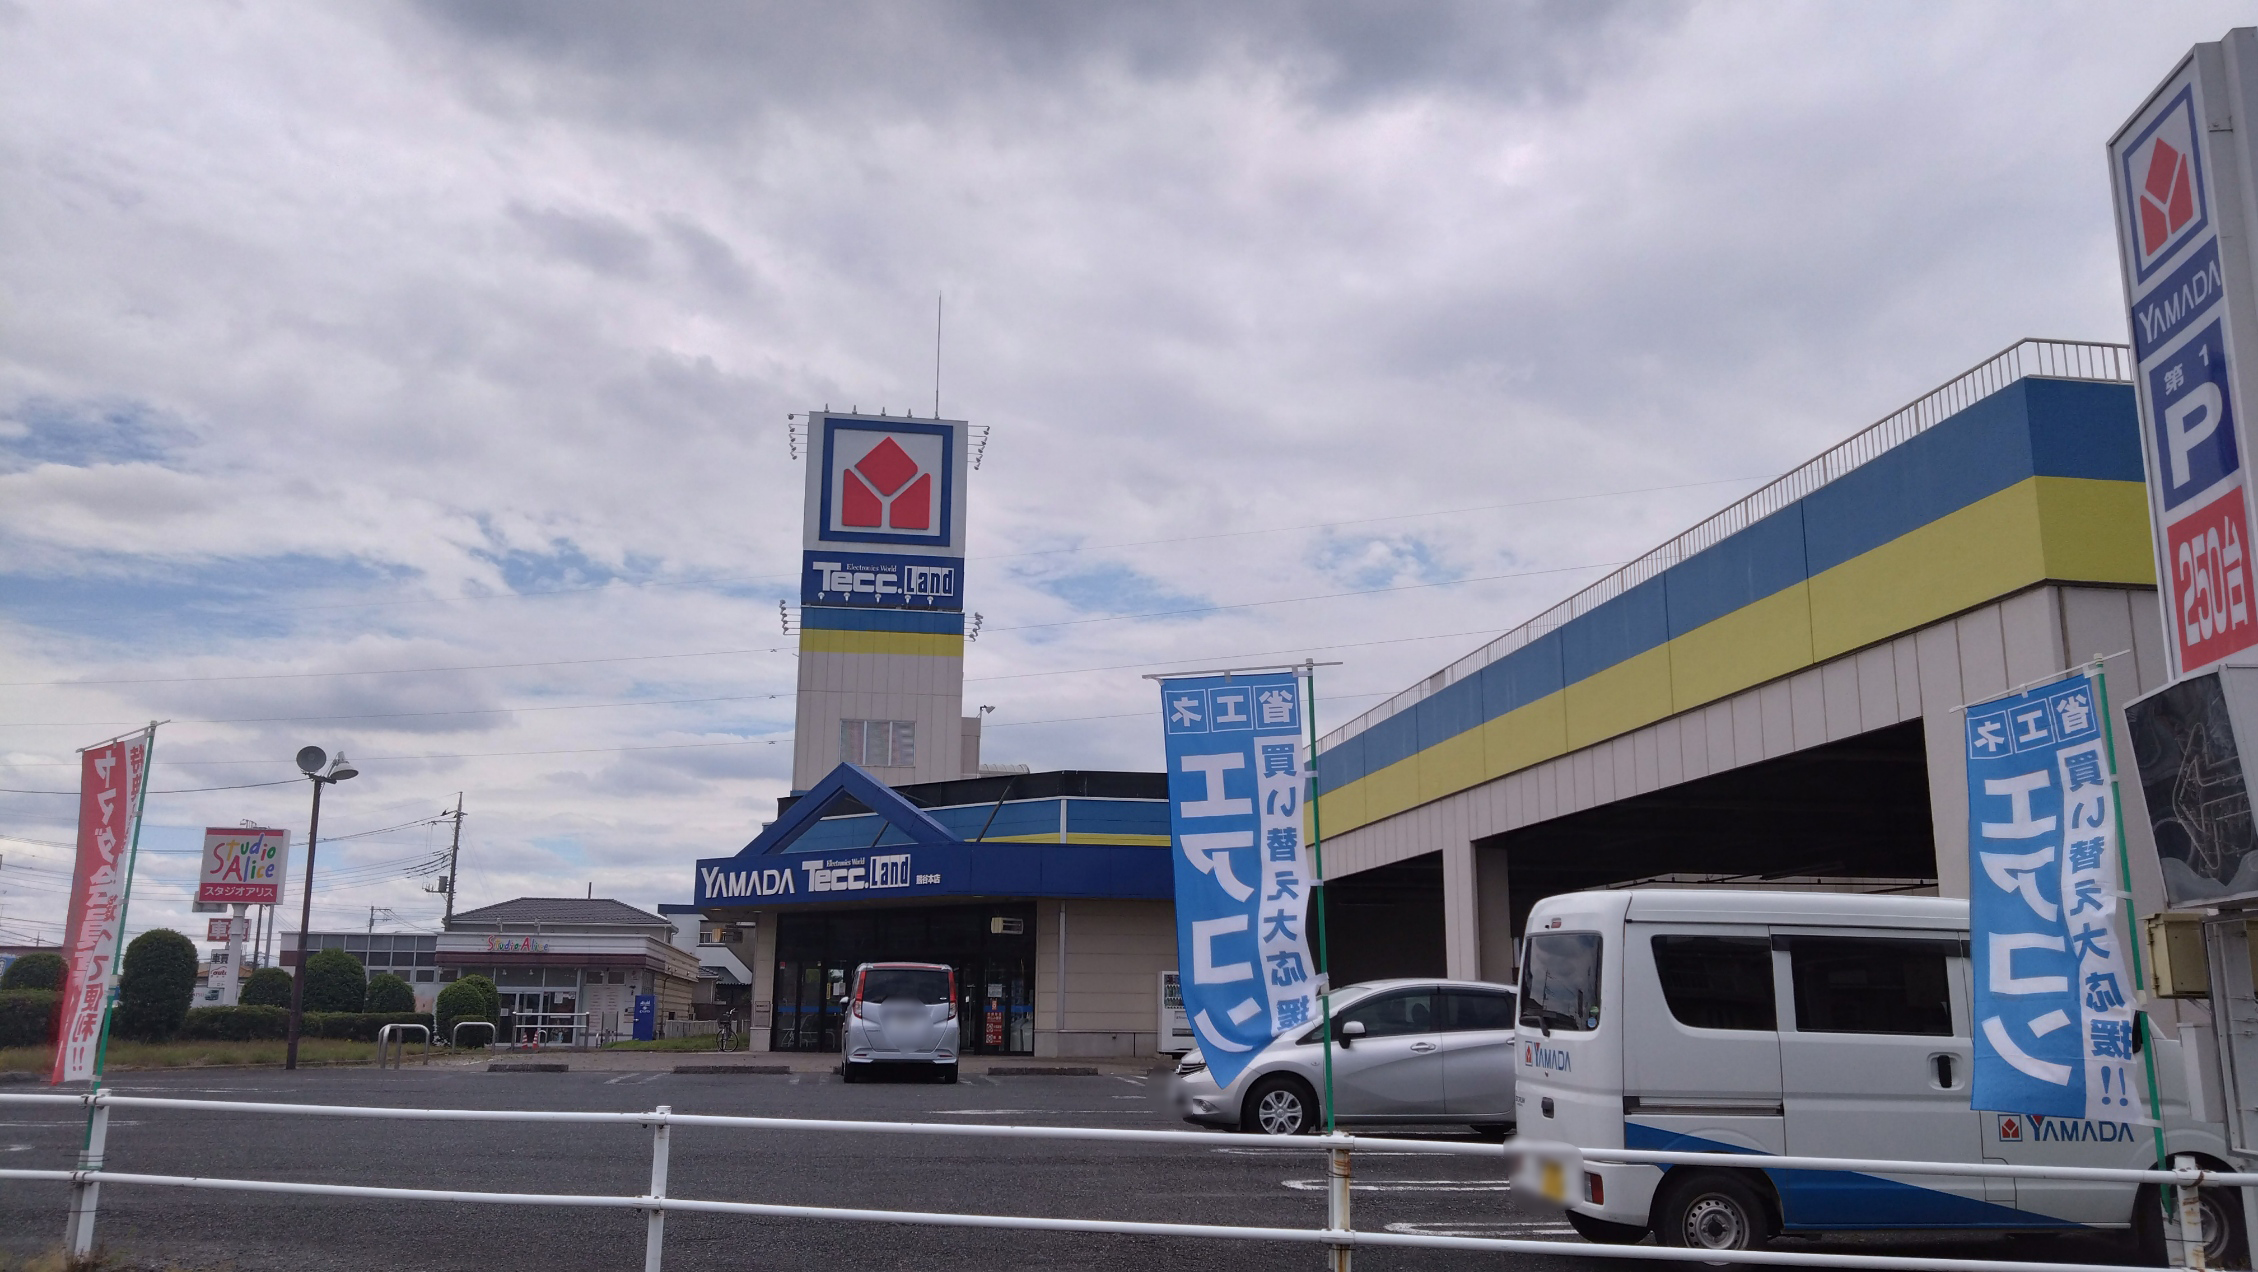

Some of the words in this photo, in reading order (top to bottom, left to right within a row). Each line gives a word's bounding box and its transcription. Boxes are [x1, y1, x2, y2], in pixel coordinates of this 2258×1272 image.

[2139, 260, 2221, 344] YAMADA
[2165, 381, 2223, 489] P
[880, 565, 897, 573] World
[2179, 516, 2248, 646] 250台
[209, 833, 276, 874] Studio
[222, 855, 275, 882] Alice
[205, 886, 274, 897] スタジオアリス
[700, 866, 795, 898] YAMADA
[487, 935, 519, 951] Studio
[520, 936, 549, 951] Alice
[1533, 1042, 1572, 1072] YAMADA
[2026, 1114, 2134, 1142] YAMADA
